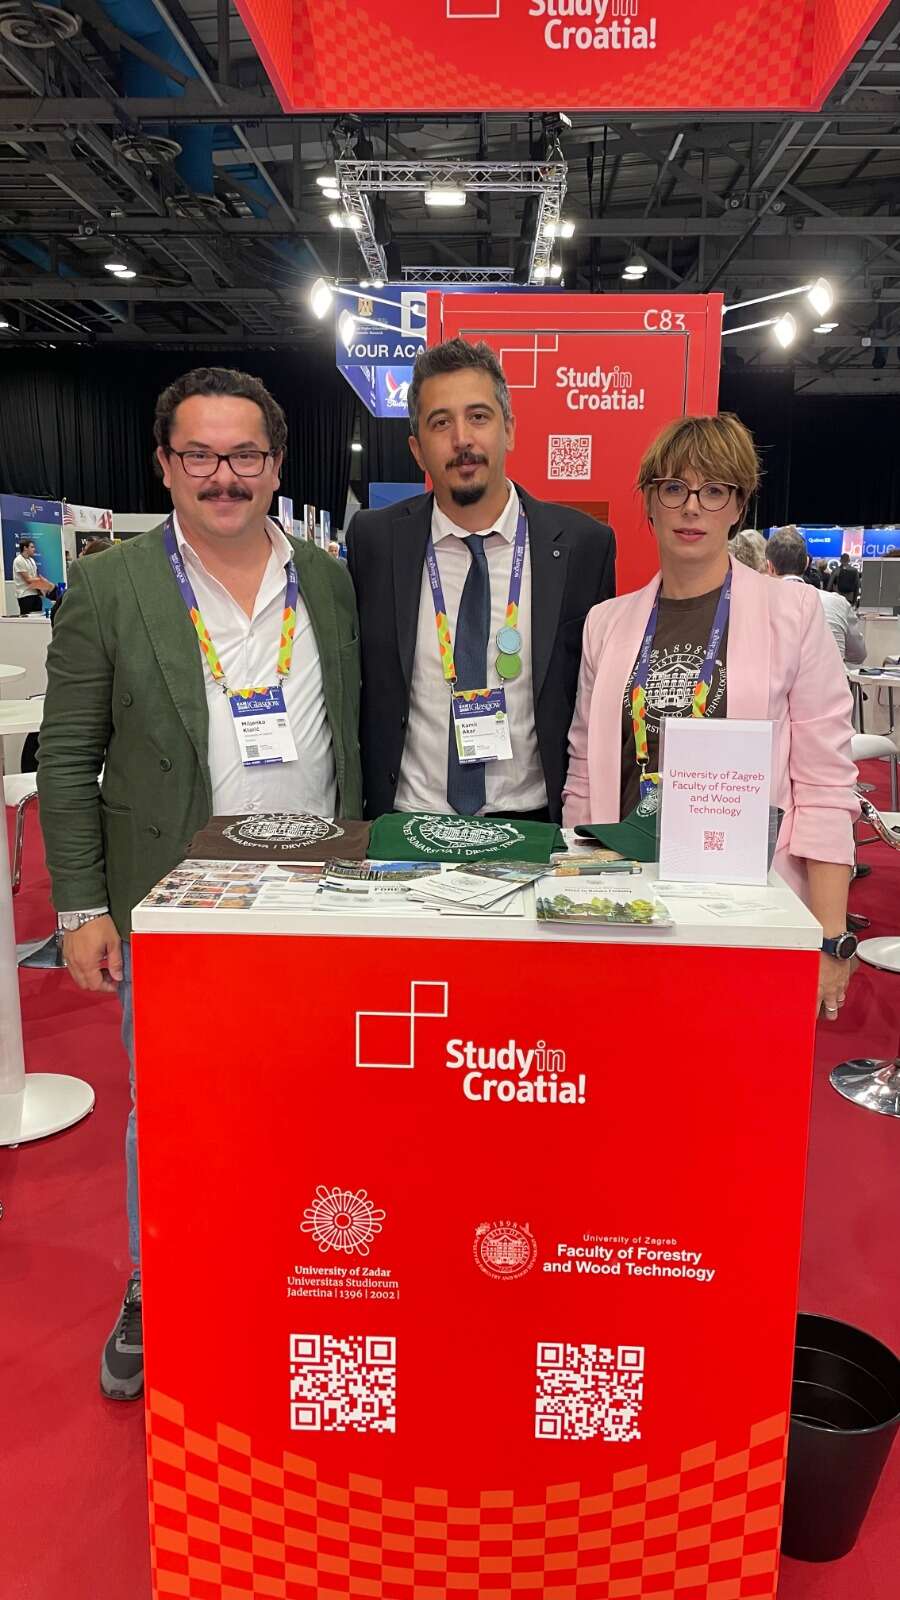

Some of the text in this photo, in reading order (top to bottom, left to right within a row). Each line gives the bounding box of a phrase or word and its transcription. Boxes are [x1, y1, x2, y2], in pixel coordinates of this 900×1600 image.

[544, 17, 657, 49] Croatia!
[644, 309, 686, 331] C83
[345, 344, 389, 358] YOUR
[566, 389, 645, 410] Croatia!
[669, 769, 765, 782] University of Zagreb
[672, 781, 761, 794] Faculty of Forestry
[690, 794, 741, 803] and Wood
[688, 805, 742, 817] Technology
[463, 1072, 586, 1104] Croatia!
[582, 1234, 629, 1245] University
[644, 1237, 677, 1246] Zagreb
[557, 1243, 614, 1261] Faculty
[617, 1247, 634, 1259] of
[637, 1247, 702, 1265] Forestry
[294, 1265, 391, 1278] University of Zadar
[542, 1260, 716, 1282] and Wood Technology
[287, 1276, 399, 1288] Universitas Studiorum
[286, 1287, 333, 1298] Jadertina
[339, 1288, 363, 1299] 1396
[370, 1290, 395, 1300] 2002
